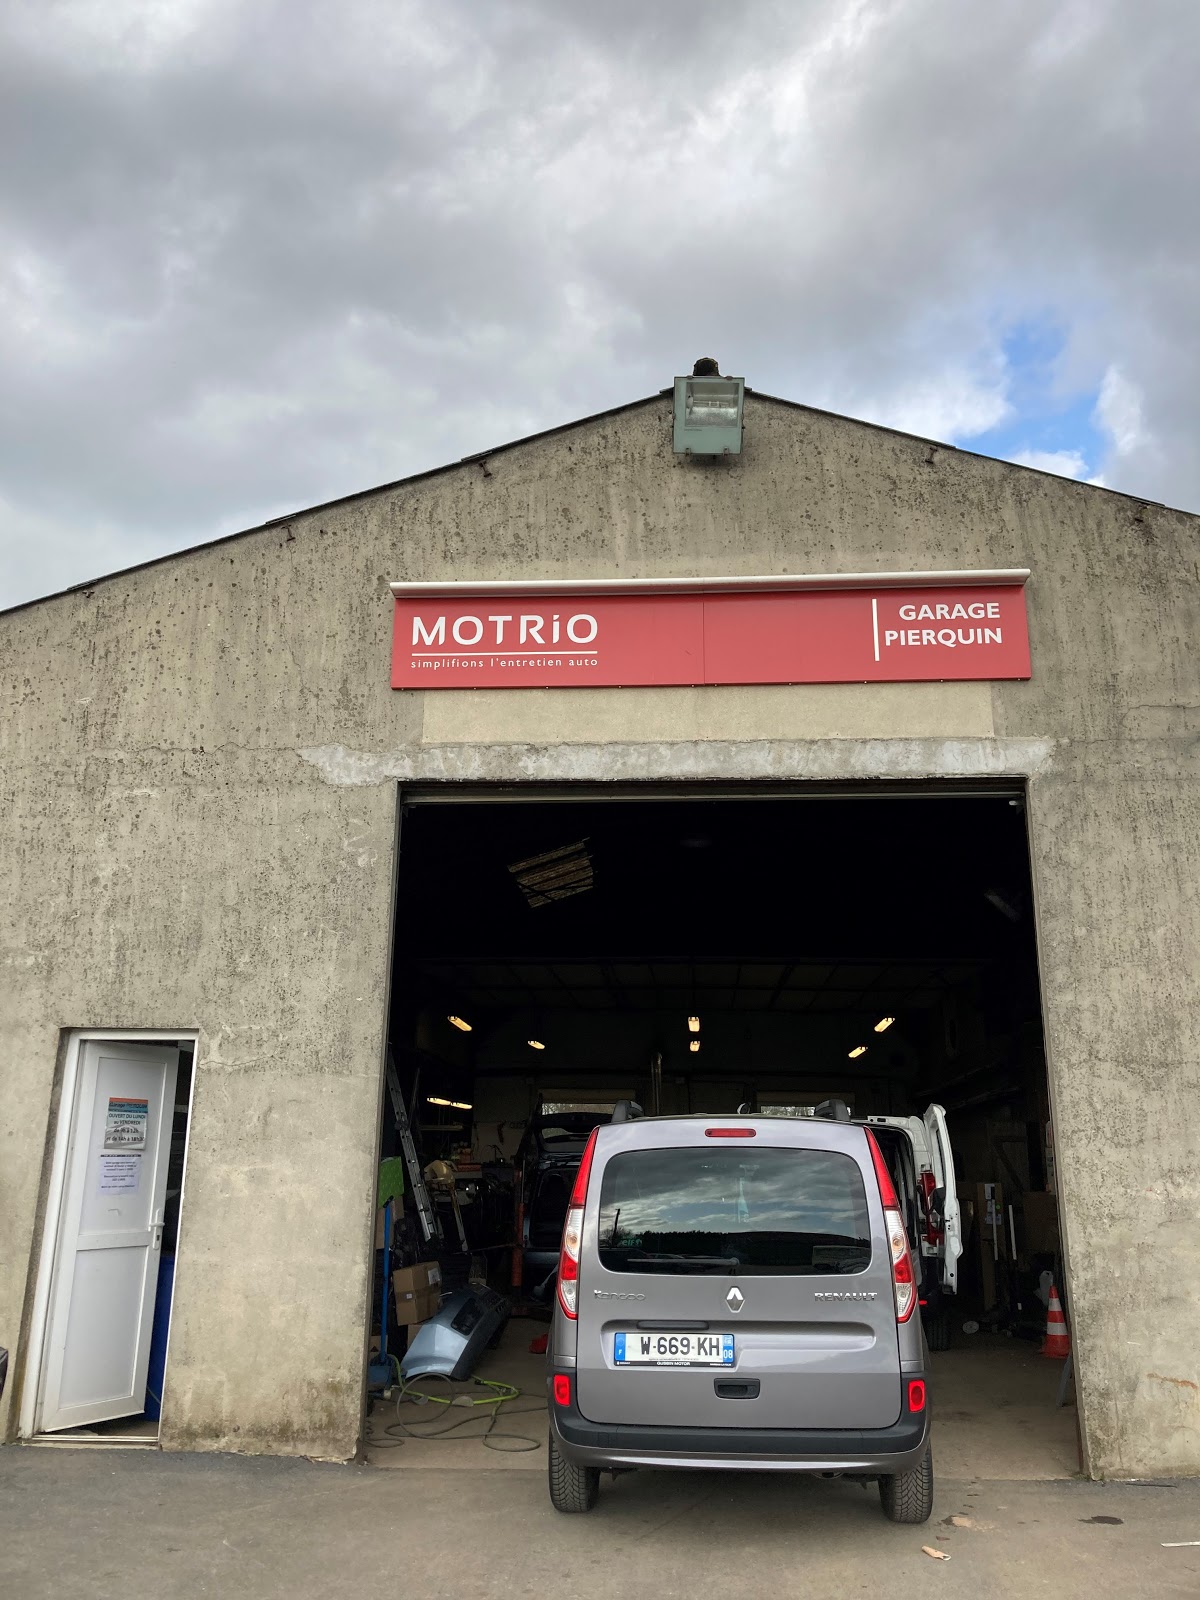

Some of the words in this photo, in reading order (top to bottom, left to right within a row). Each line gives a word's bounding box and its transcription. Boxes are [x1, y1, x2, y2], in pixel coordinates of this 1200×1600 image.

[898, 602, 1001, 621] GARAGE
[884, 627, 1003, 648] PIERQUIN
[411, 657, 484, 670] simplifions
[490, 657, 562, 667] l'entretien
[568, 657, 598, 667] auto
[814, 1292, 878, 1302] RENAULT
[723, 1349, 733, 1359] 08
